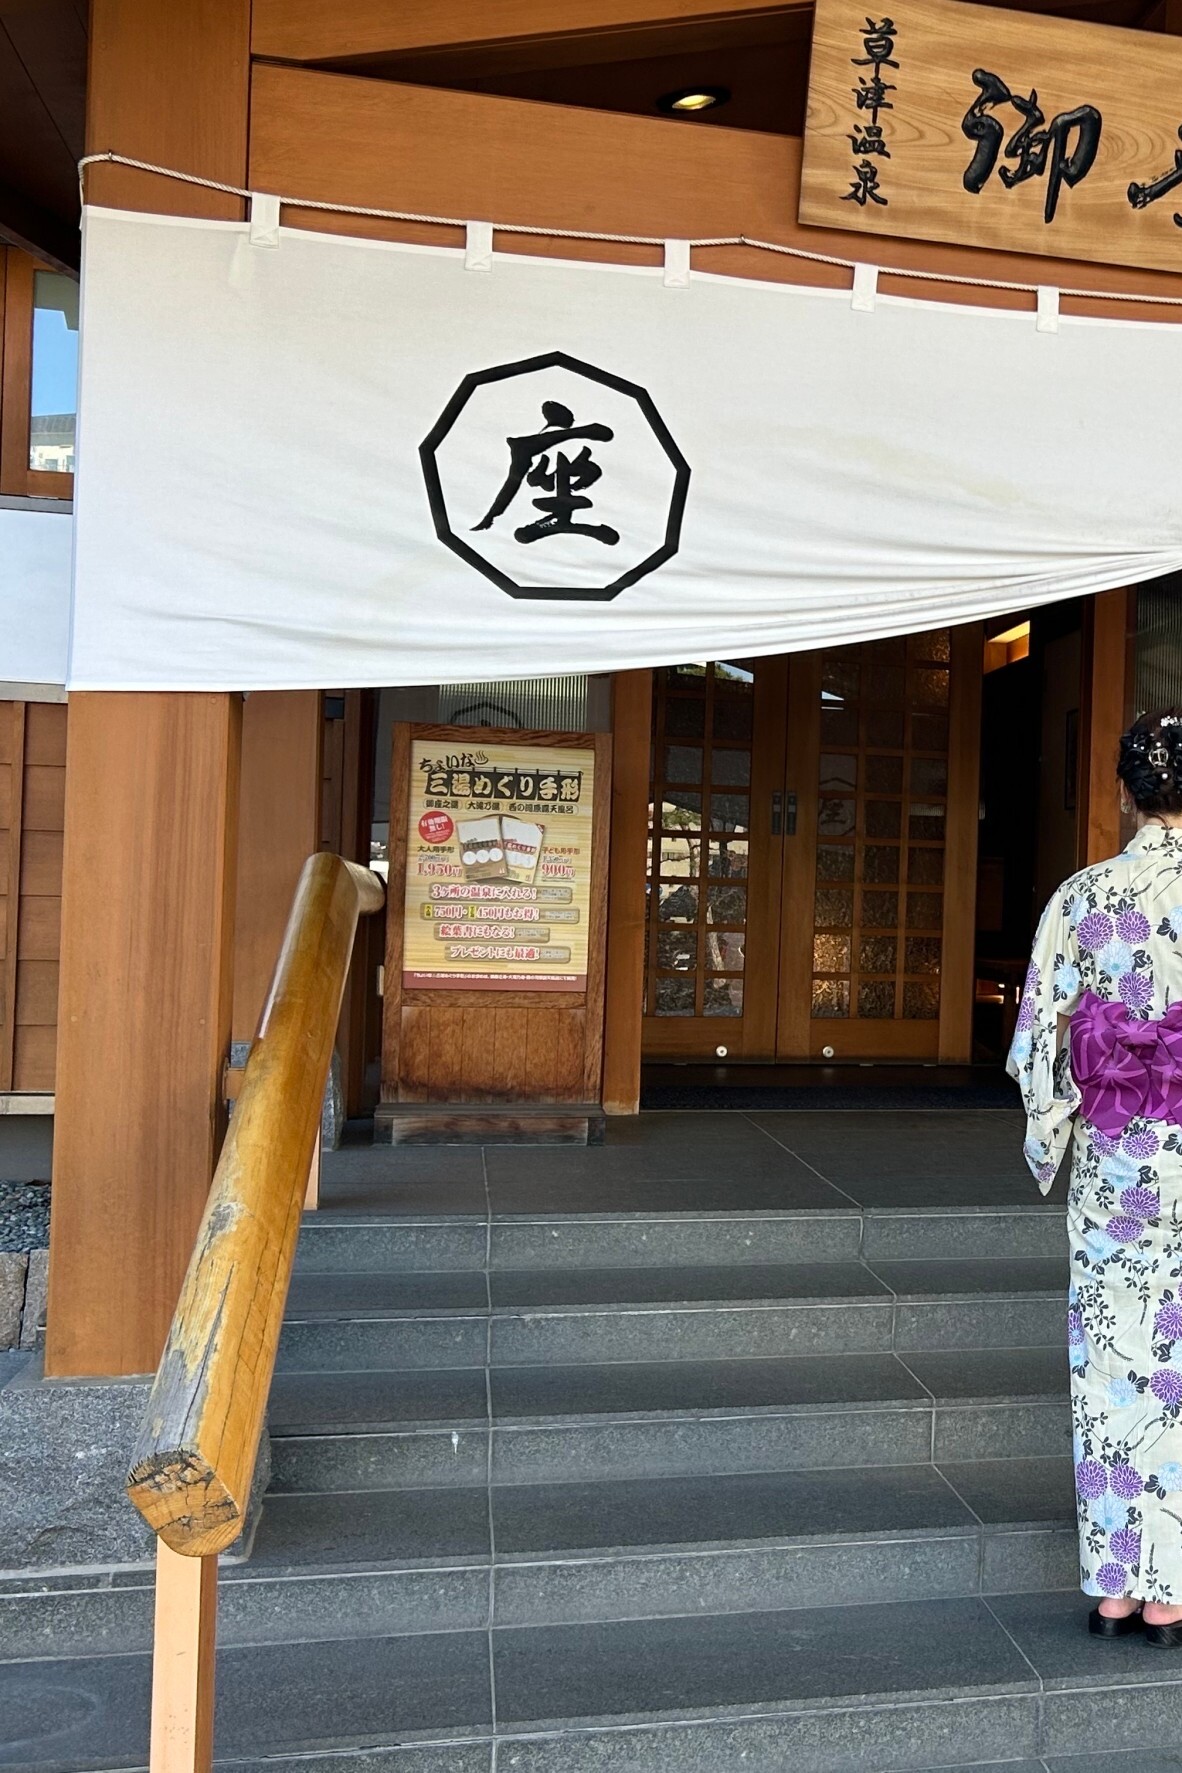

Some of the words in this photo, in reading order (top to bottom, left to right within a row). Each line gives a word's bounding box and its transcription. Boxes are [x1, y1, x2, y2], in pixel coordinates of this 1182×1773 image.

[840, 17, 900, 206] 草津温泉
[470, 400, 620, 545] 座
[429, 772, 580, 800] 三湯めぐり手形
